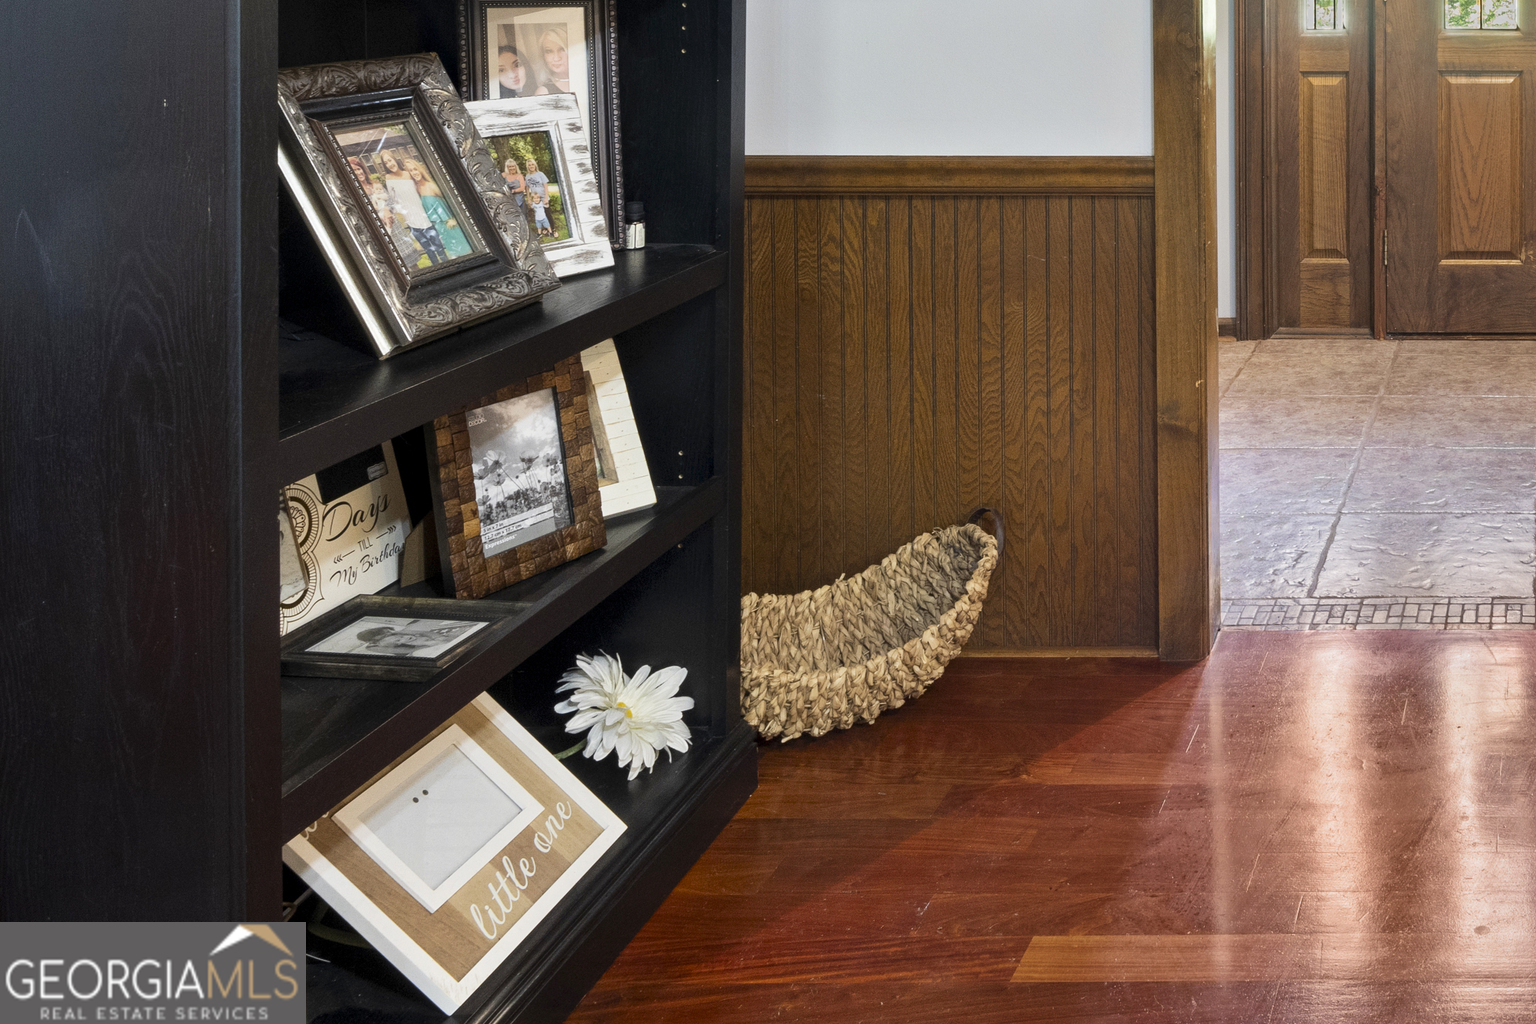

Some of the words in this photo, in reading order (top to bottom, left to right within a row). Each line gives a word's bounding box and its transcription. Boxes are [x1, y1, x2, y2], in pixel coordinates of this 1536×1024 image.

[323, 493, 392, 542] Days
[357, 536, 374, 552] TILL
[329, 565, 359, 587] My
[469, 853, 536, 941] little
[533, 799, 572, 854] one
